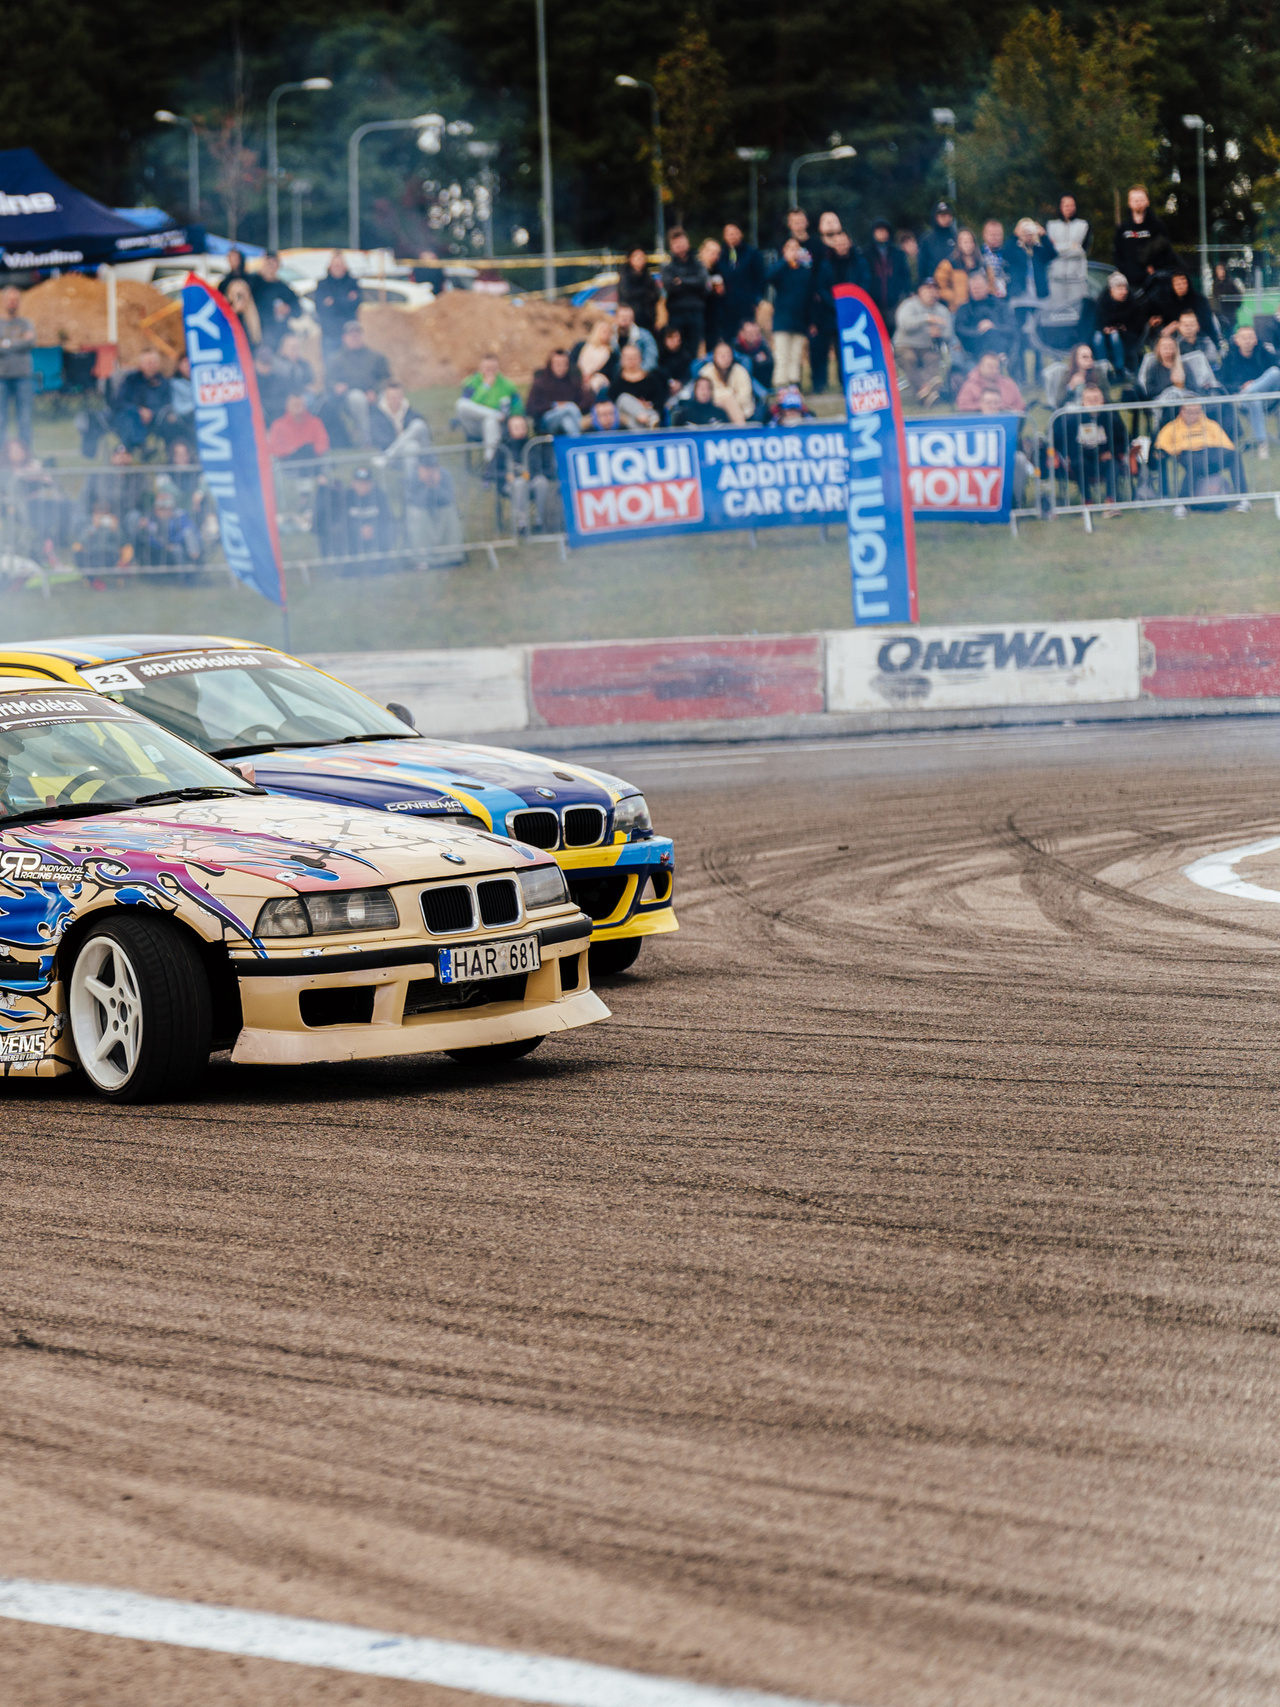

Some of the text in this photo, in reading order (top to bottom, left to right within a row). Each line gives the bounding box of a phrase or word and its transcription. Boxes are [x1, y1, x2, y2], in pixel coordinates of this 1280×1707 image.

[704, 432, 849, 465] MOTOR OIL
[908, 430, 998, 468] IQUI
[576, 444, 692, 489] LIQUI
[717, 457, 849, 490] ADDITIVE
[581, 481, 697, 527] MOLY
[722, 488, 783, 517] CAR
[95, 673, 128, 685] 23
[20, 871, 83, 881] RACING PARTS
[38, 864, 85, 874] INDIVIDUAL
[454, 948, 498, 978] HAR
[509, 941, 536, 971] 681
